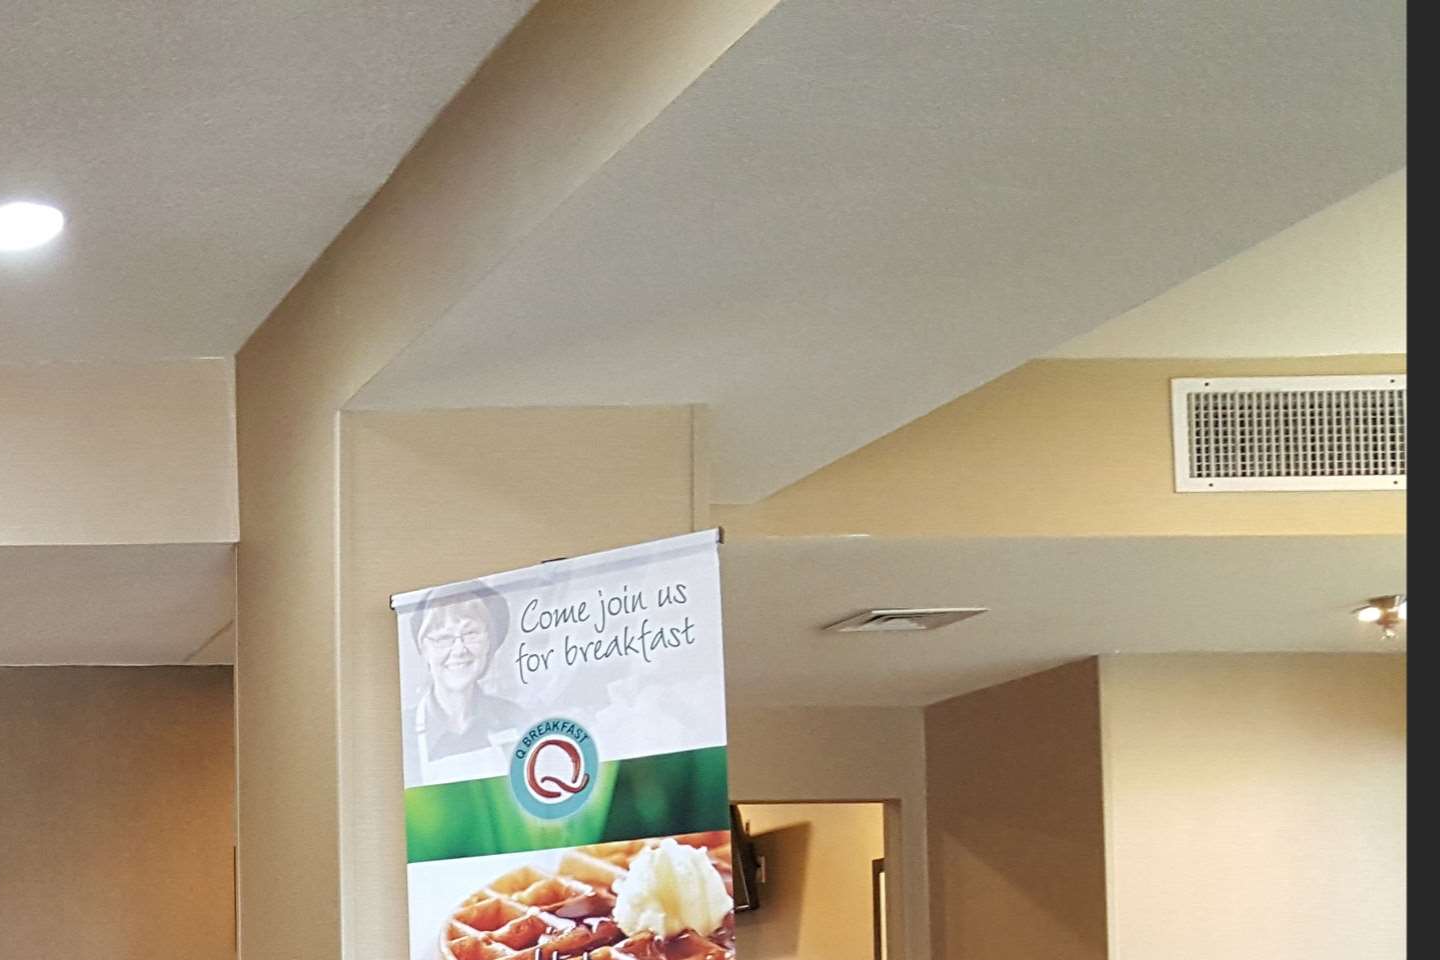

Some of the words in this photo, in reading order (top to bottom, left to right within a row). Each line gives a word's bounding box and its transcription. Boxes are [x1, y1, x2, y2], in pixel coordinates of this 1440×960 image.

[521, 599, 590, 633] Come
[594, 585, 647, 634] join
[658, 584, 687, 607] us
[515, 642, 554, 684] for
[565, 617, 695, 665] breakfast
[515, 749, 526, 760] Q
[522, 721, 589, 748] BREAKFAST
[527, 739, 590, 799] Q
